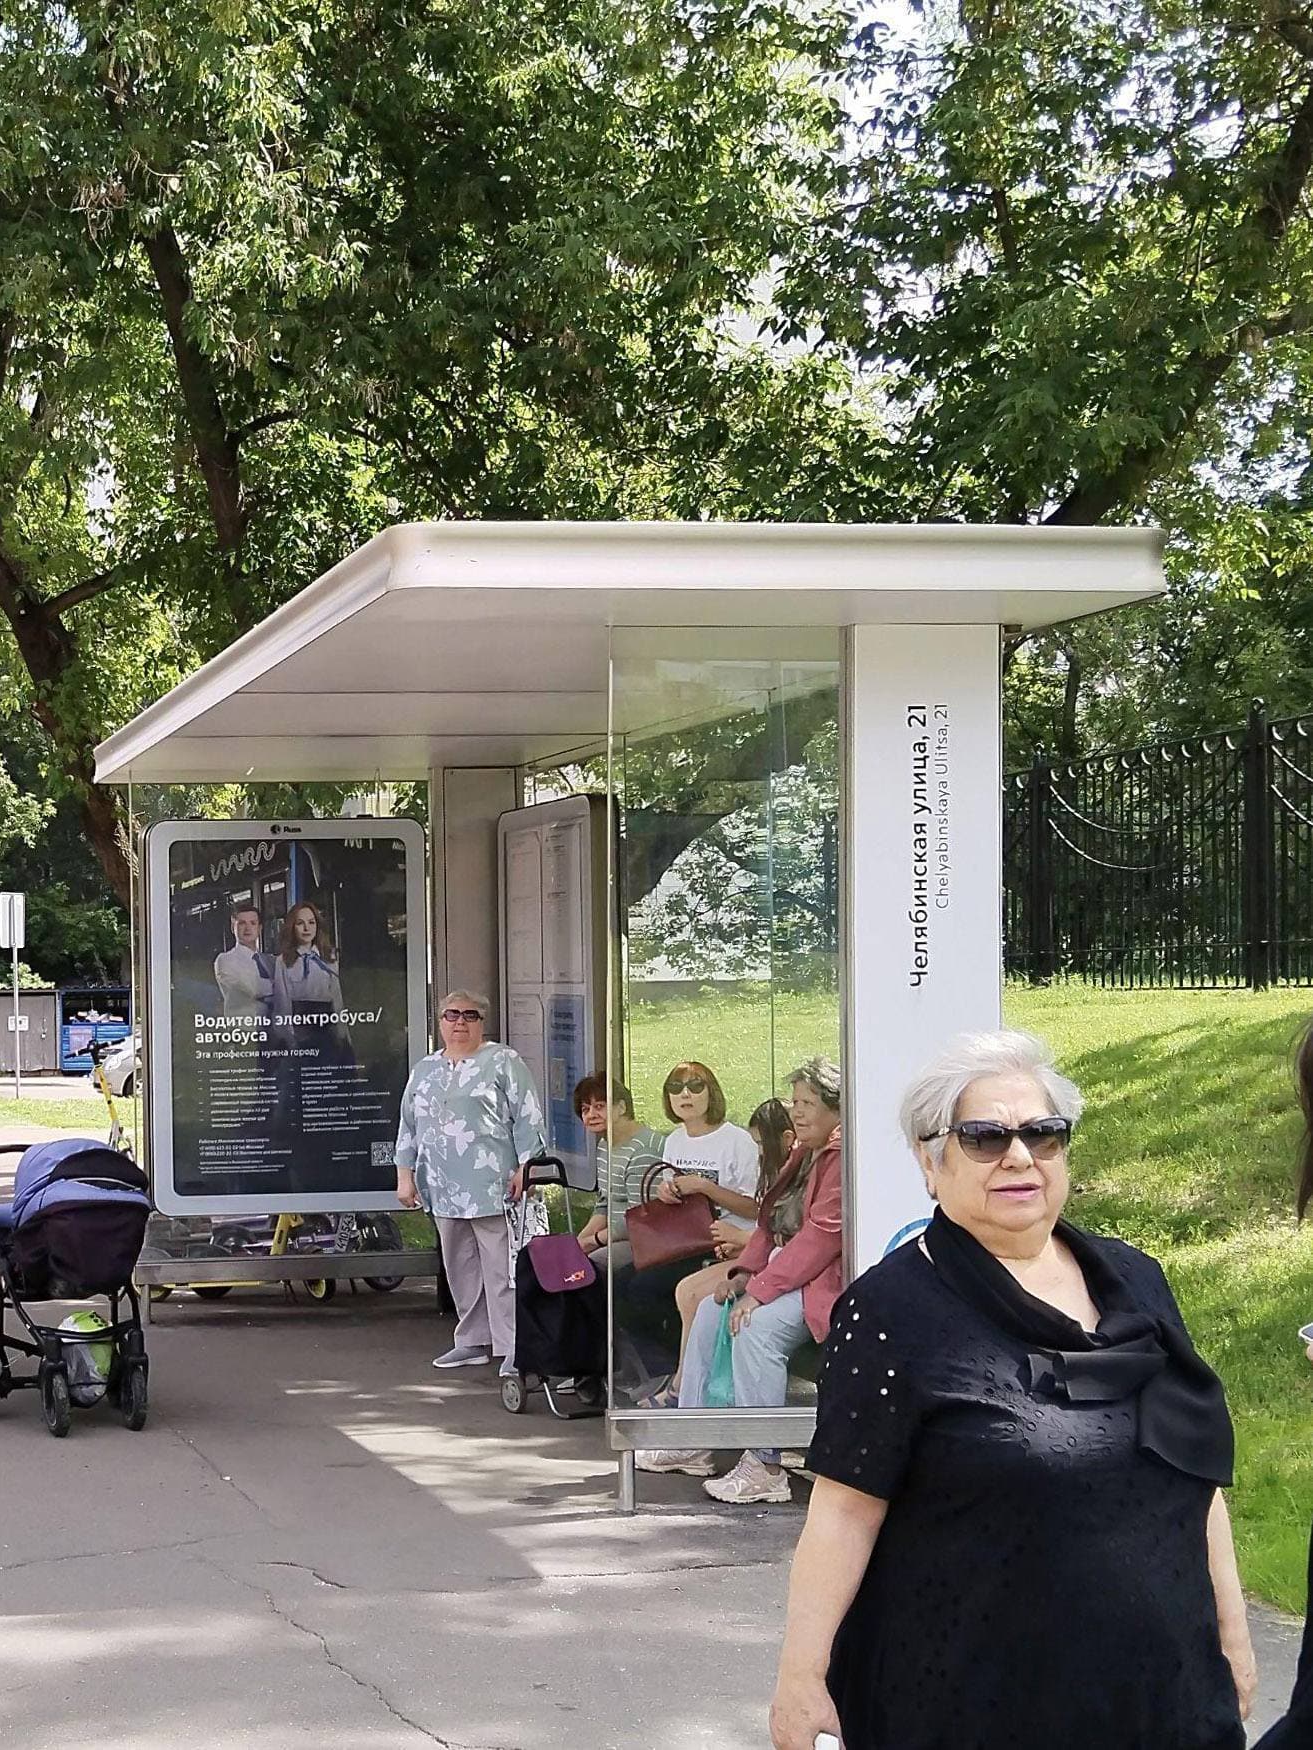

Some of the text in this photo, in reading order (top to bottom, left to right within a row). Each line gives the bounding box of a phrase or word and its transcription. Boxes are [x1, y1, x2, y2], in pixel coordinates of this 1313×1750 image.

[934, 704, 951, 909] Chelyabinskaya Ulitsa, 21
[907, 704, 933, 988] Челябинская улица, 21
[194, 1006, 383, 1030] Водитель электробуса/
[195, 1029, 268, 1046] автобуса
[195, 1048, 320, 1060] Эта профессия нужна городу
